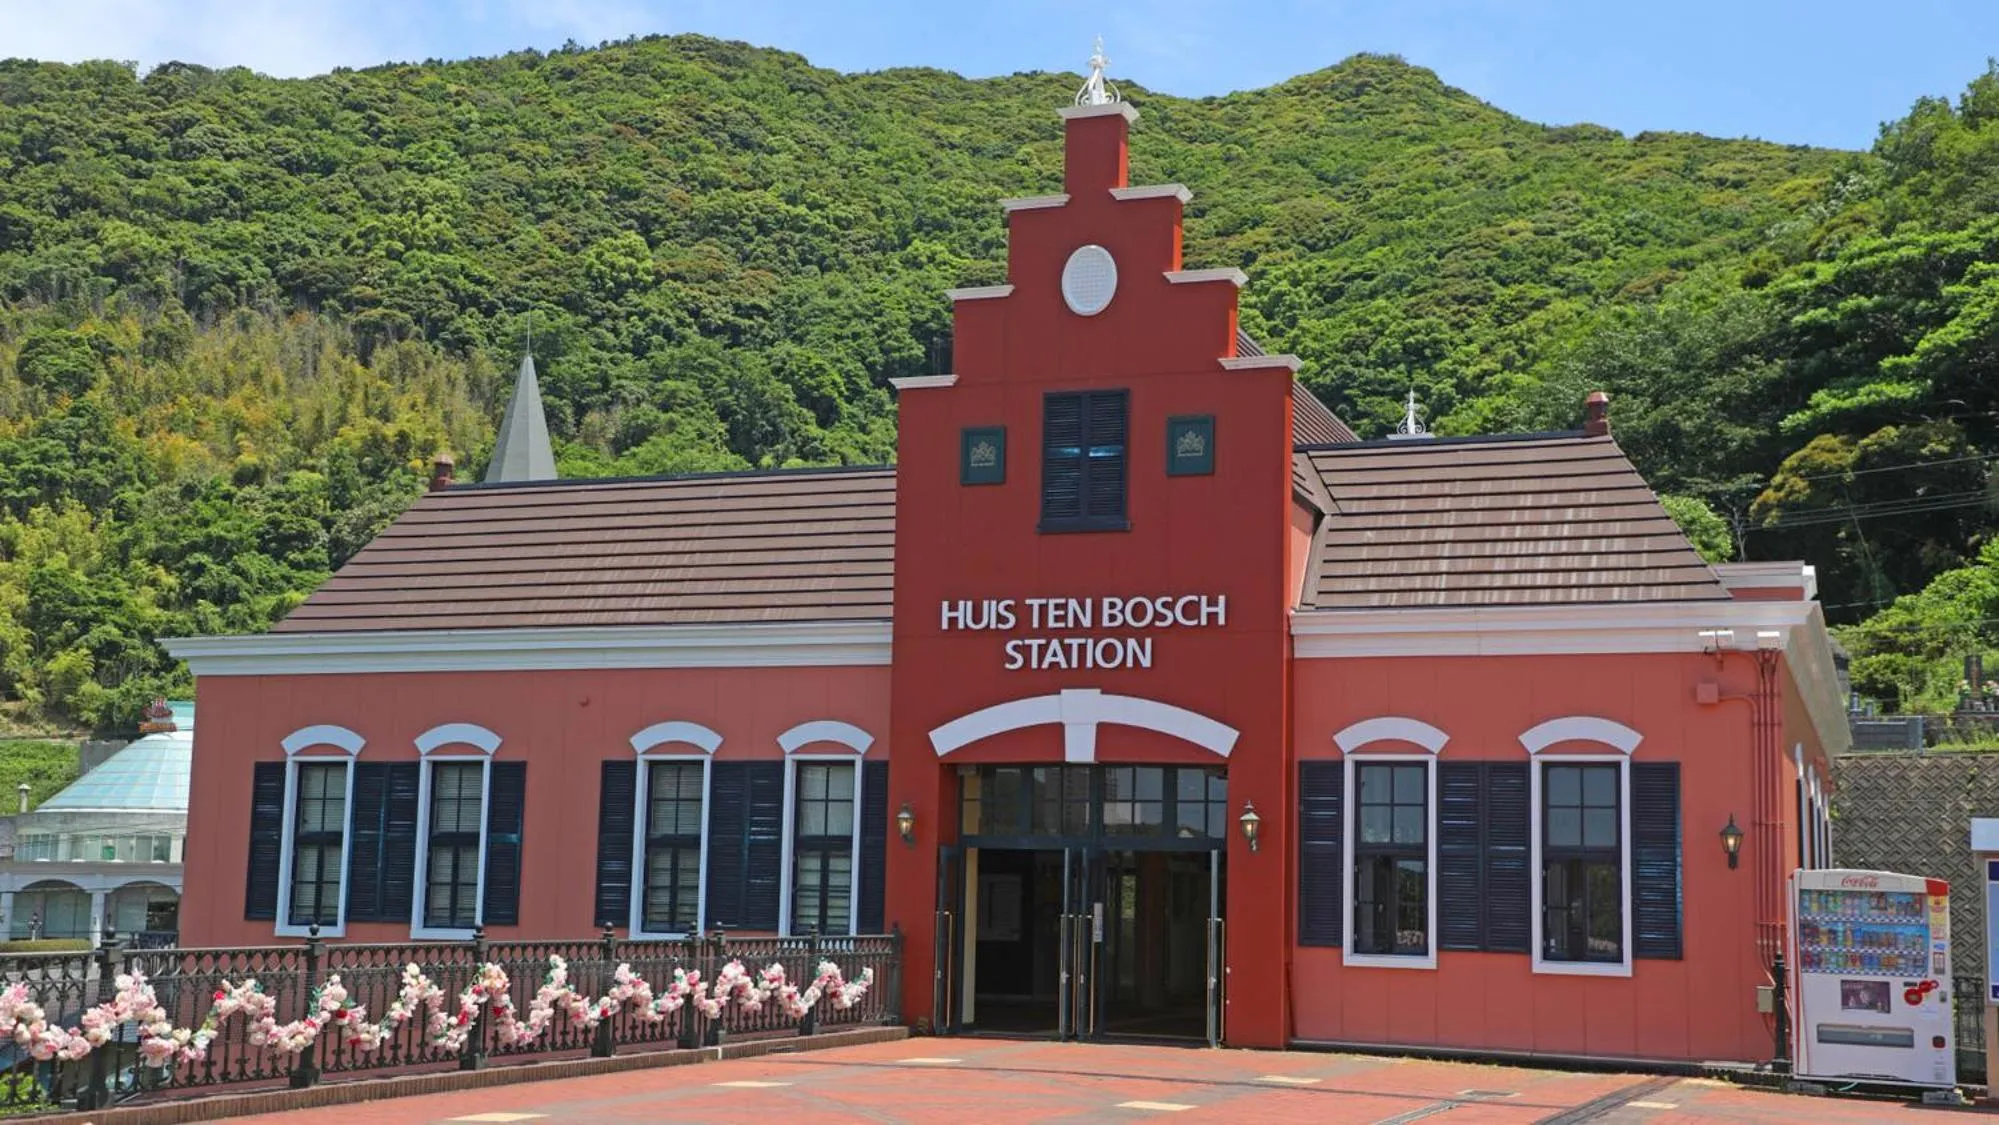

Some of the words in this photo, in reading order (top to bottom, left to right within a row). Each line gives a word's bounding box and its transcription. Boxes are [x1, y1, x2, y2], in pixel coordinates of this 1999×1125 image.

[941, 599, 1016, 630] HUIS
[1025, 597, 1092, 629] TEN
[1102, 594, 1226, 628] BOSCH
[1004, 637, 1152, 670] STATION
